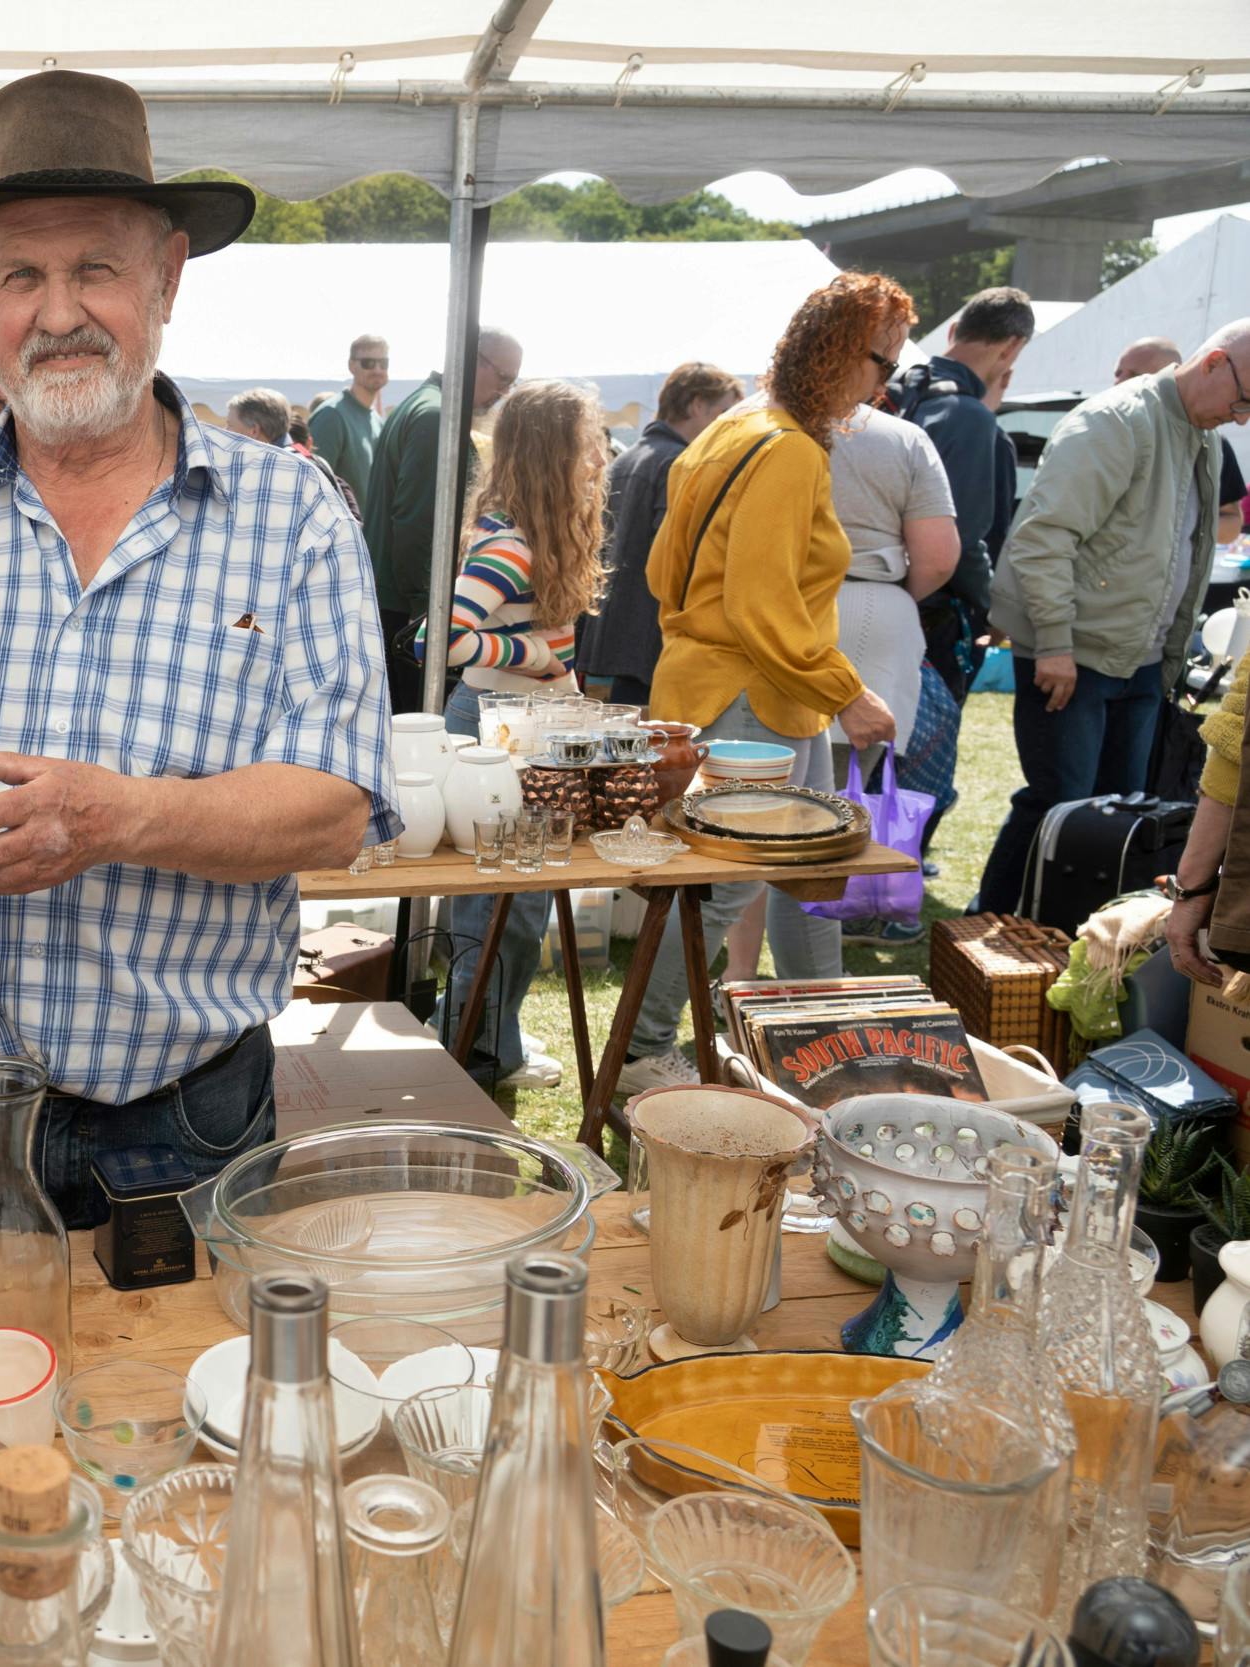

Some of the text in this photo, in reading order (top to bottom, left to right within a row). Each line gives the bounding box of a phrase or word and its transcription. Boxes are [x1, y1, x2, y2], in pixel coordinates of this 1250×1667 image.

[1206, 995, 1230, 1011] Ekstra
[782, 1028, 971, 1083] SOUTH PACIFIC
